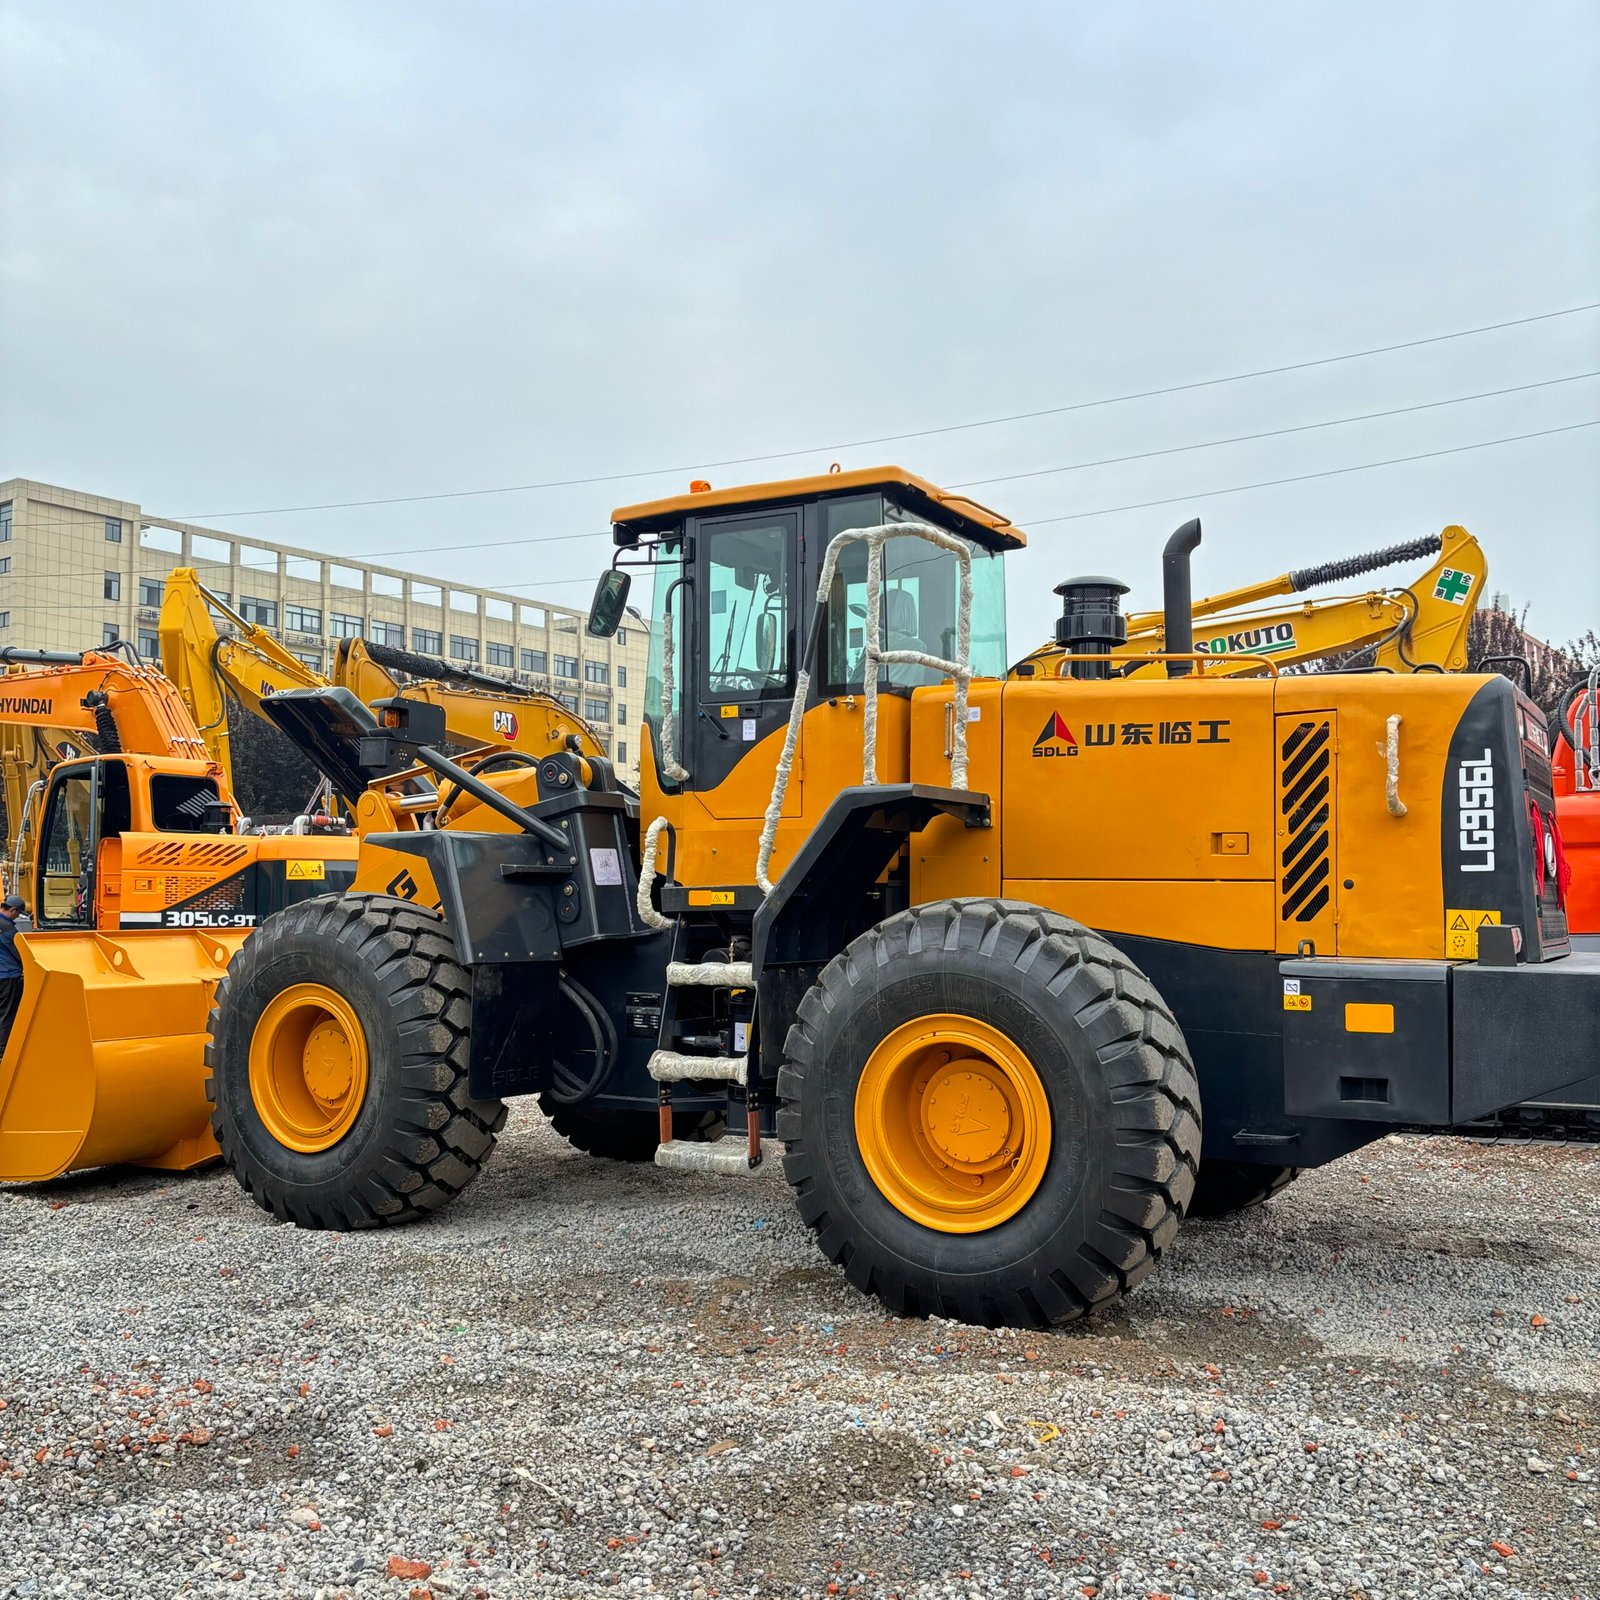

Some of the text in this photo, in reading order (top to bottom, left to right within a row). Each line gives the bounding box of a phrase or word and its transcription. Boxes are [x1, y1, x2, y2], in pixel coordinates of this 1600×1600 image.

[1194, 623, 1293, 654] SOKUTO
[493, 710, 513, 734] CAT
[1085, 720, 1231, 747] 山东临工
[1032, 746, 1079, 758] SDLG
[1459, 748, 1495, 872] LG956L
[166, 911, 256, 927] 305LC-9T
